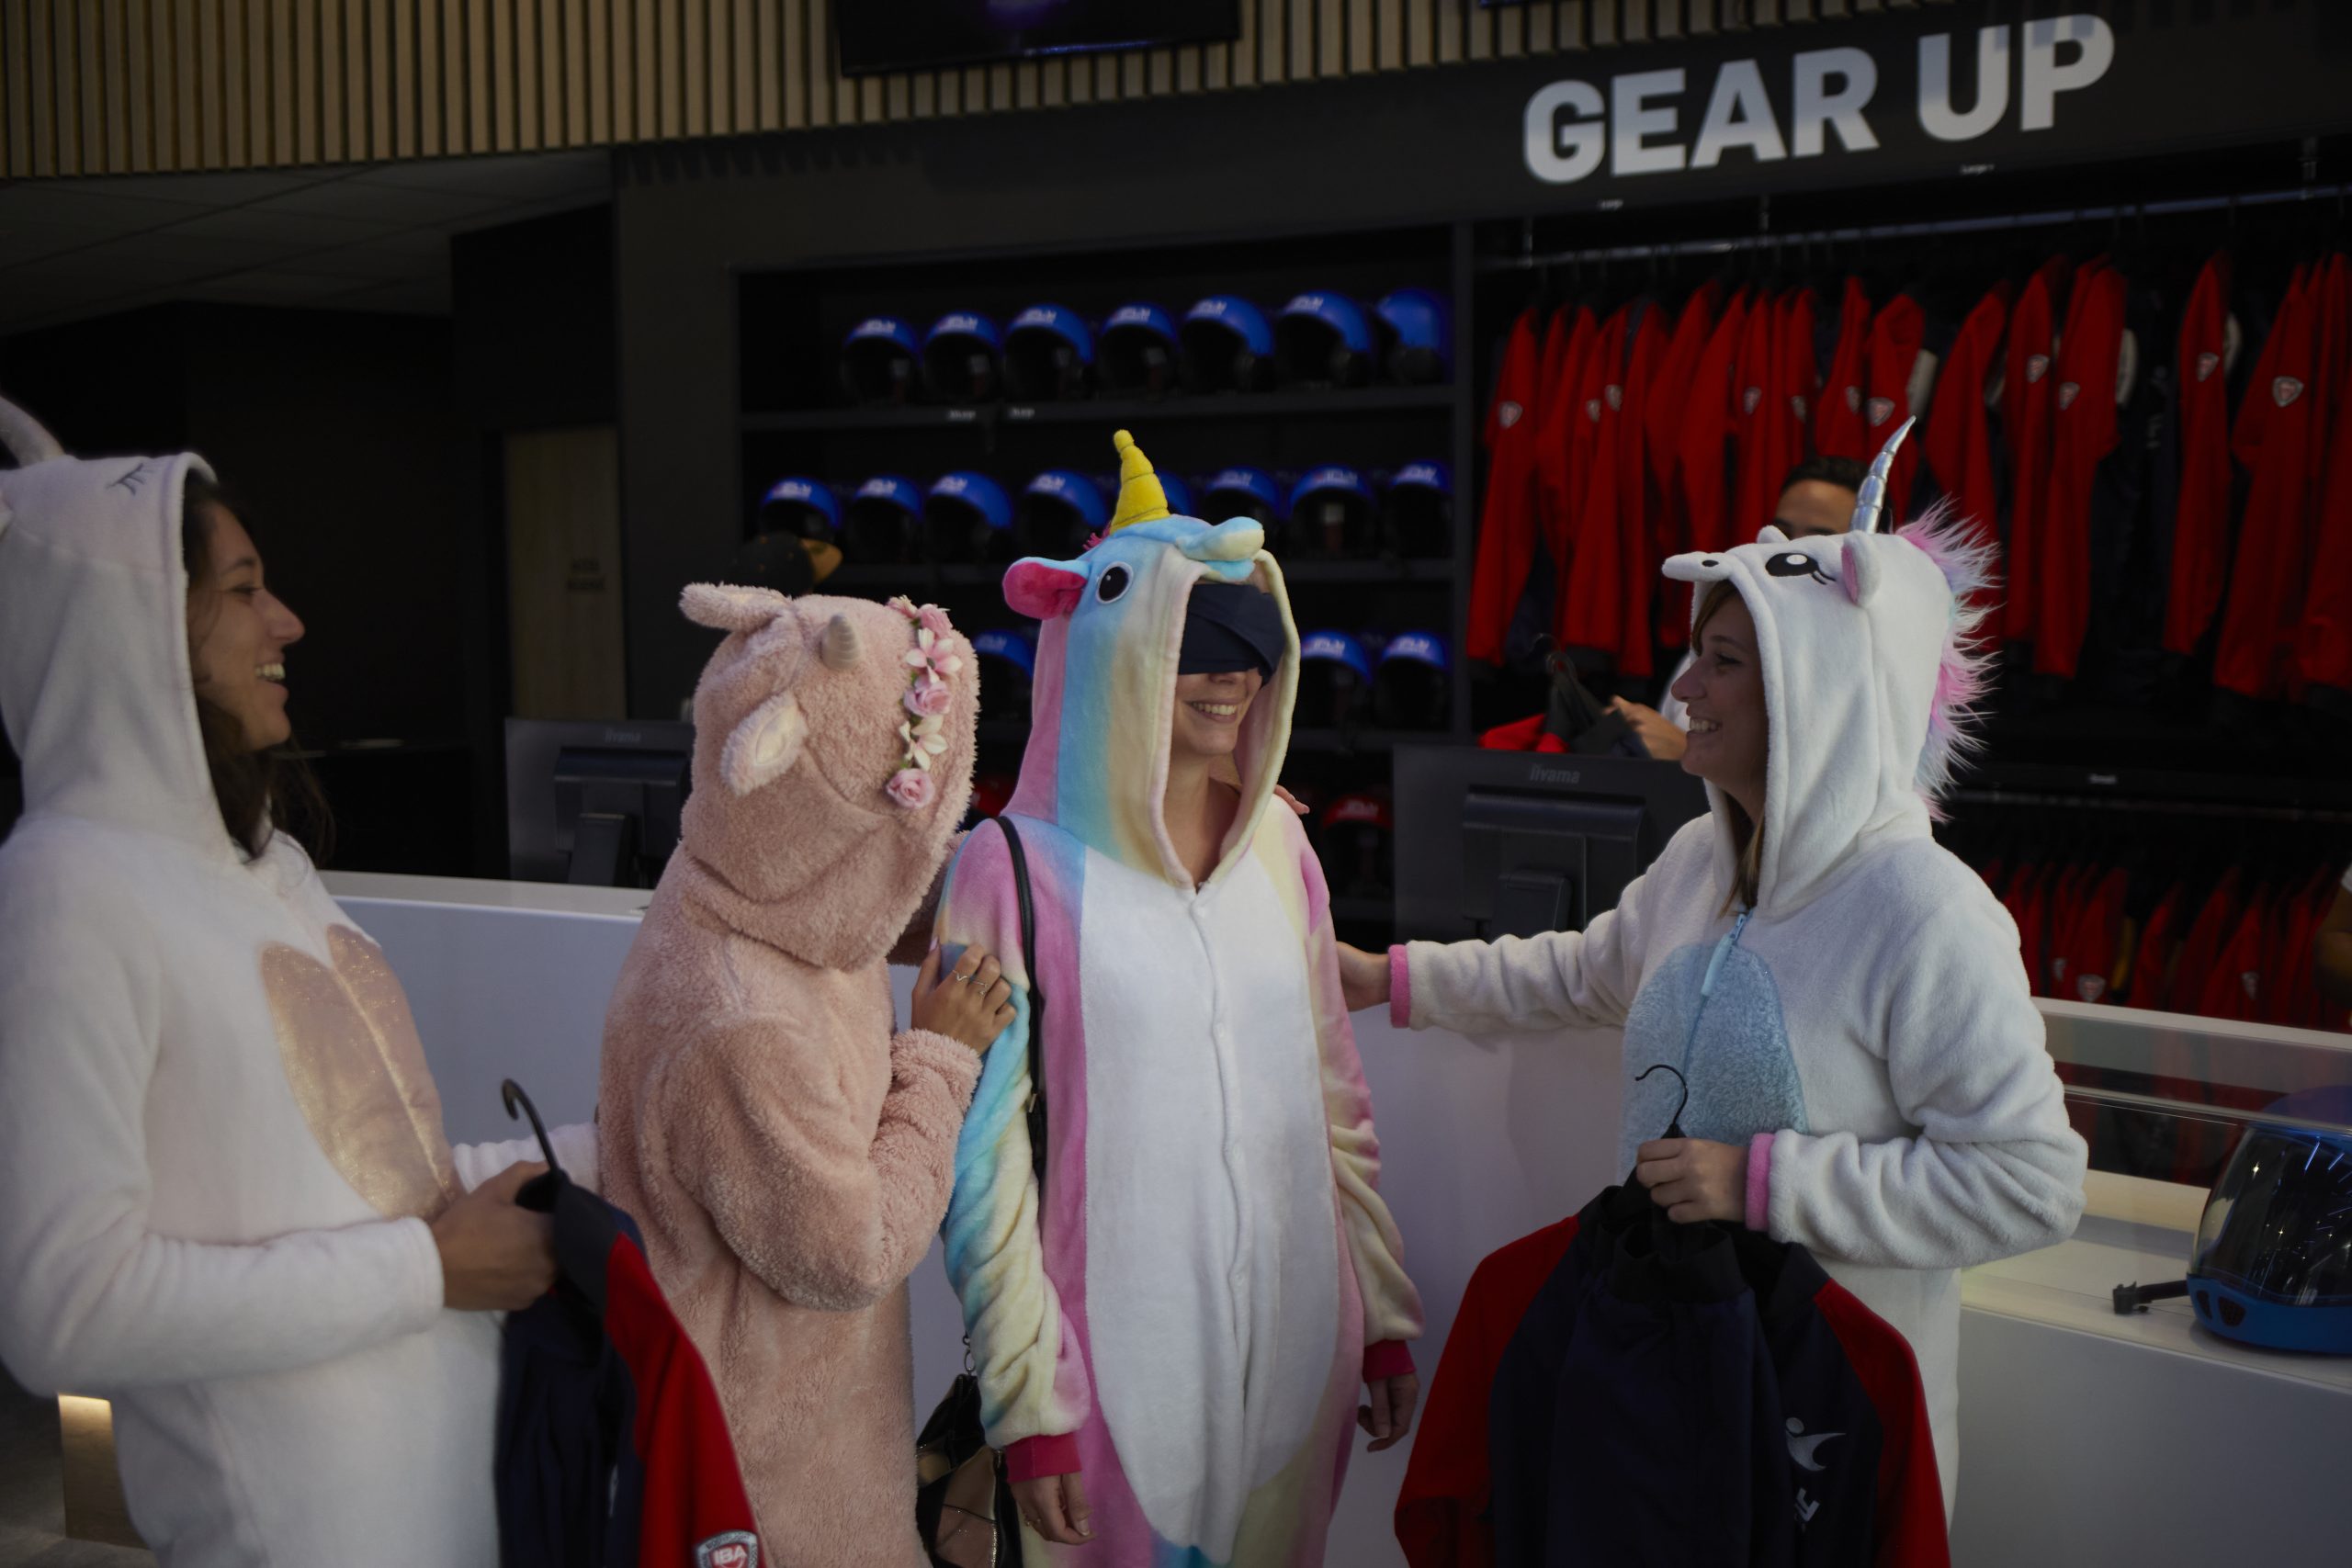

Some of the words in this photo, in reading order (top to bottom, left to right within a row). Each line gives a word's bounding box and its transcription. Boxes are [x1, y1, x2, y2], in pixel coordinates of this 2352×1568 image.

[1523, 46, 1880, 185] GEAR
[1917, 14, 2115, 141] UP
[712, 1544, 748, 1566] IBA
